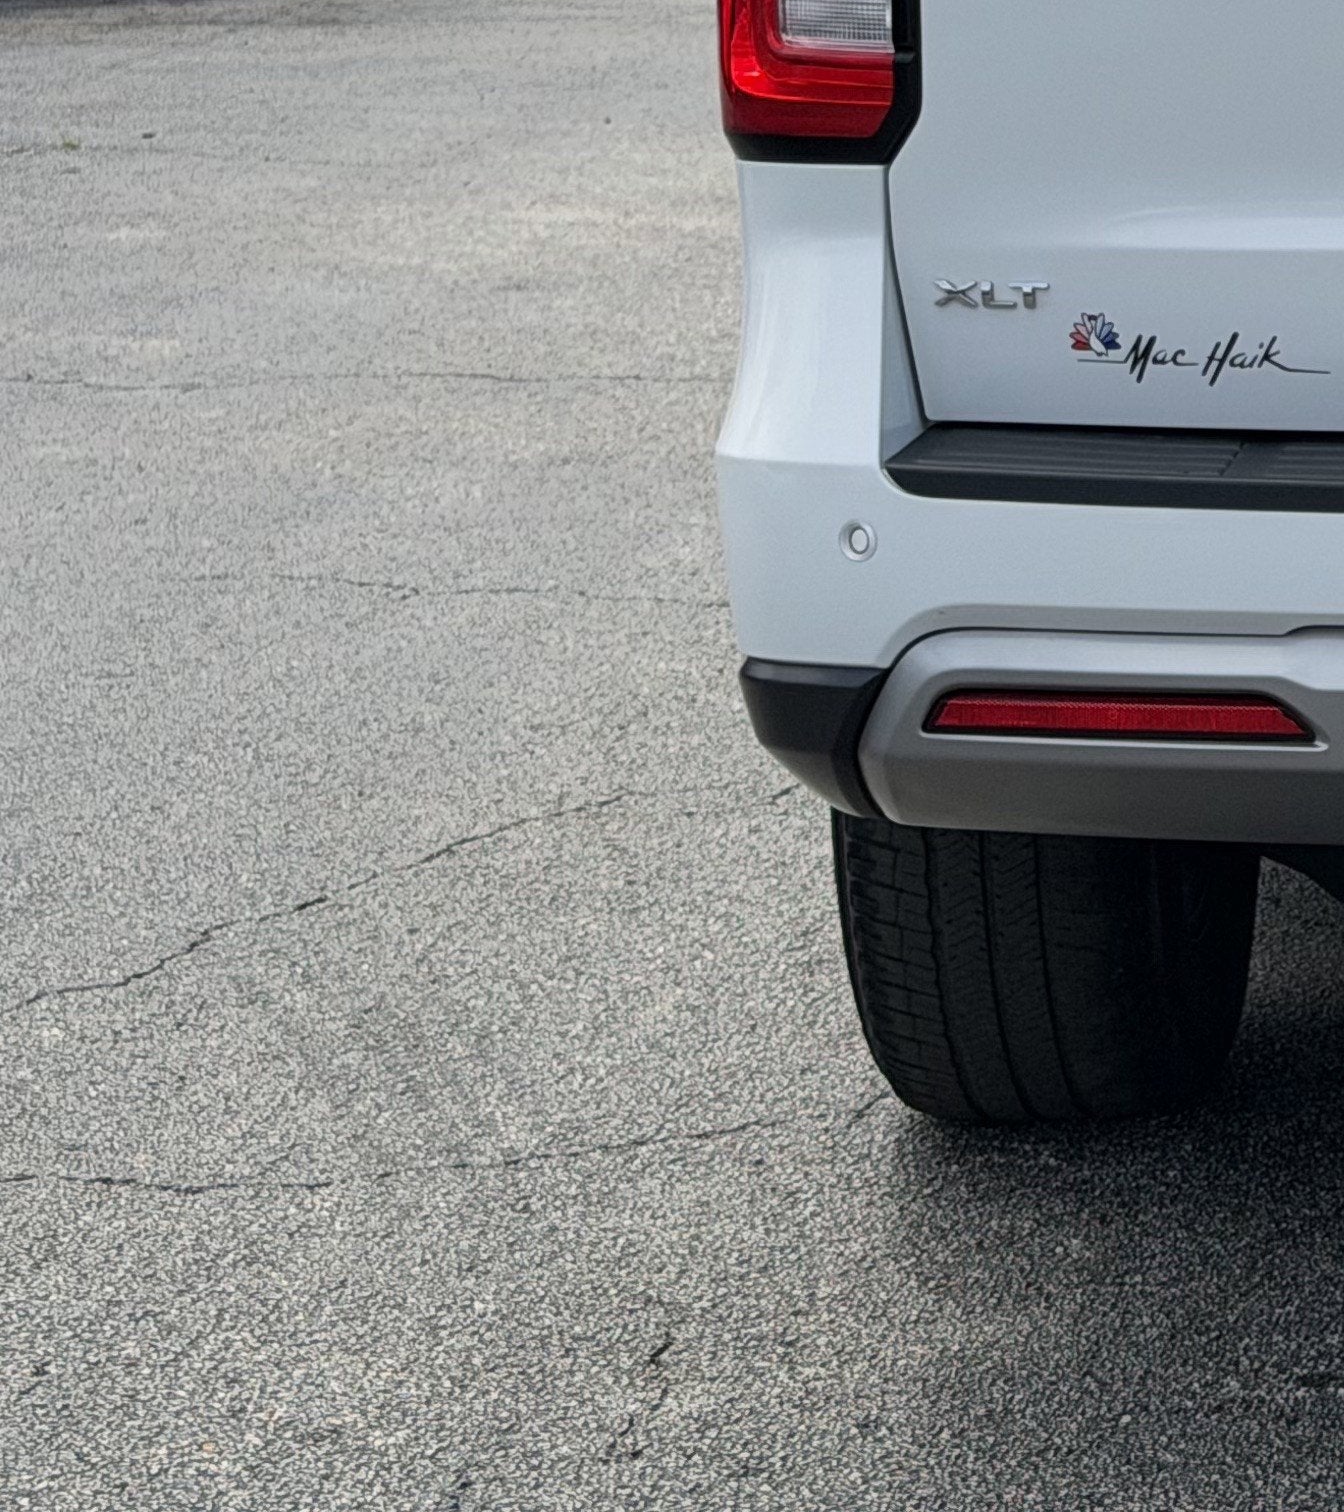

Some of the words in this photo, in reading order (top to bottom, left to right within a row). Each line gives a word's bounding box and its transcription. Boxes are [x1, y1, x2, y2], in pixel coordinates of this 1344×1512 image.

[933, 278, 1051, 310] XLT
[1123, 333, 1200, 384] Mac
[1201, 331, 1331, 387] Haik
